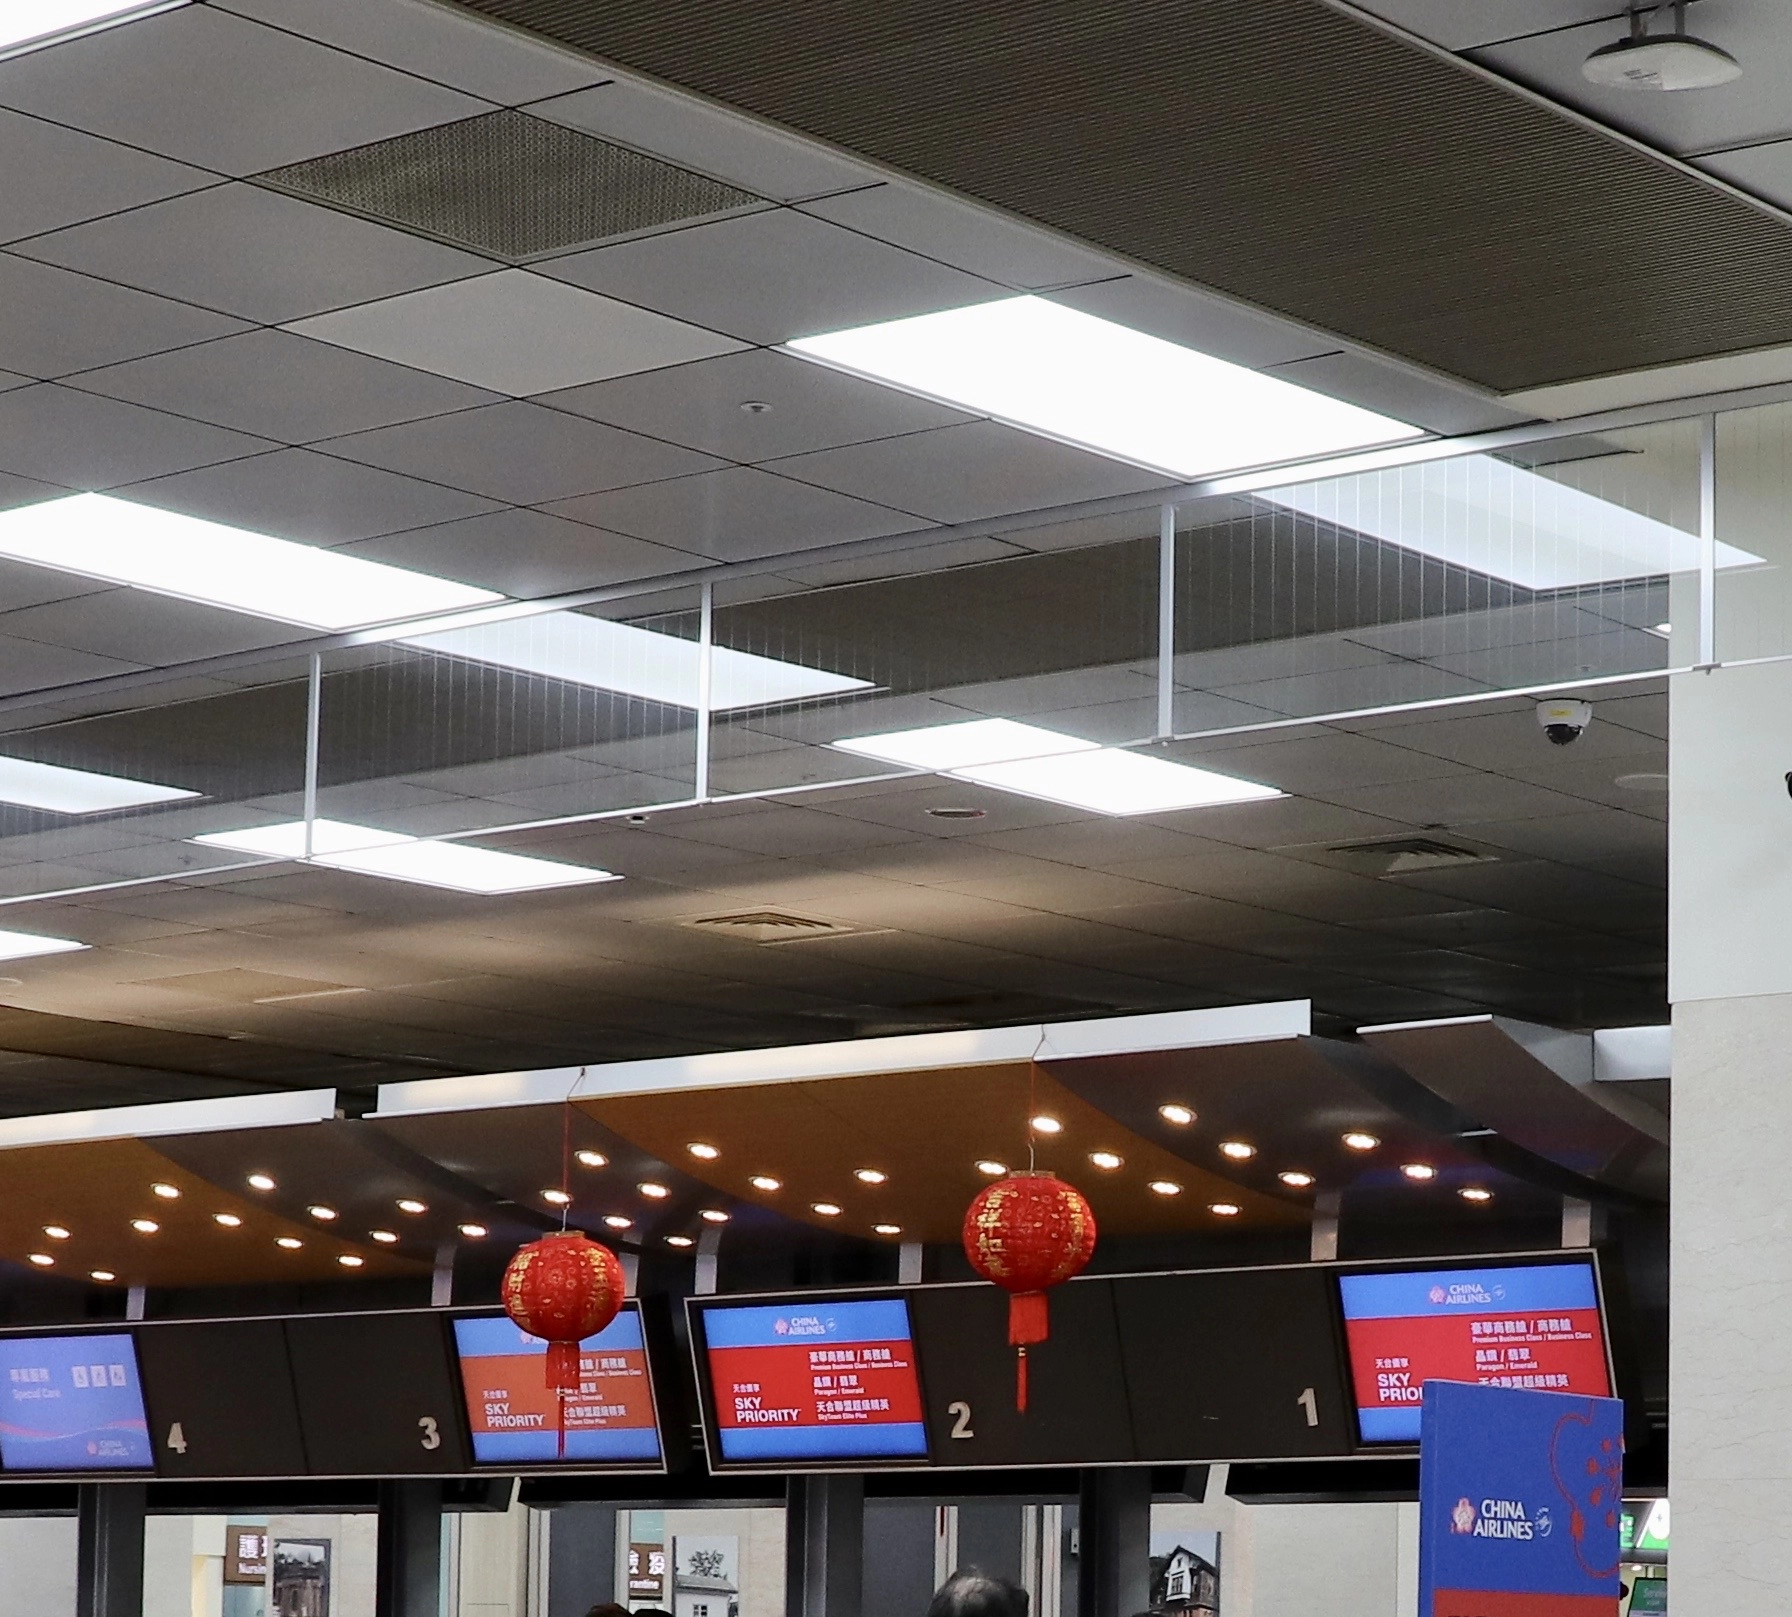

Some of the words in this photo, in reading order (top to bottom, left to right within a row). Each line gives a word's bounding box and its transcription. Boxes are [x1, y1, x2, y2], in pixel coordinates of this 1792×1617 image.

[1449, 1284, 1484, 1294] CHINA
[1445, 1293, 1492, 1305] AIRLINES
[791, 1317, 818, 1326] CHINA
[788, 1325, 825, 1336] AIRLINES
[1377, 1373, 1412, 1387] SKY
[1379, 1386, 1423, 1401] PRIO
[485, 1403, 509, 1415] SKY
[735, 1396, 762, 1410] SKY
[1297, 1387, 1320, 1427] 1
[487, 1414, 545, 1427] PRIORITY
[736, 1409, 798, 1423] PRIORITY
[948, 1401, 975, 1439] 2
[167, 1422, 188, 1454] 4
[418, 1416, 441, 1450] 3
[1481, 1499, 1526, 1520] CHINA
[1473, 1519, 1534, 1540] AIRLINES
[238, 1562, 267, 1574] Nursin
